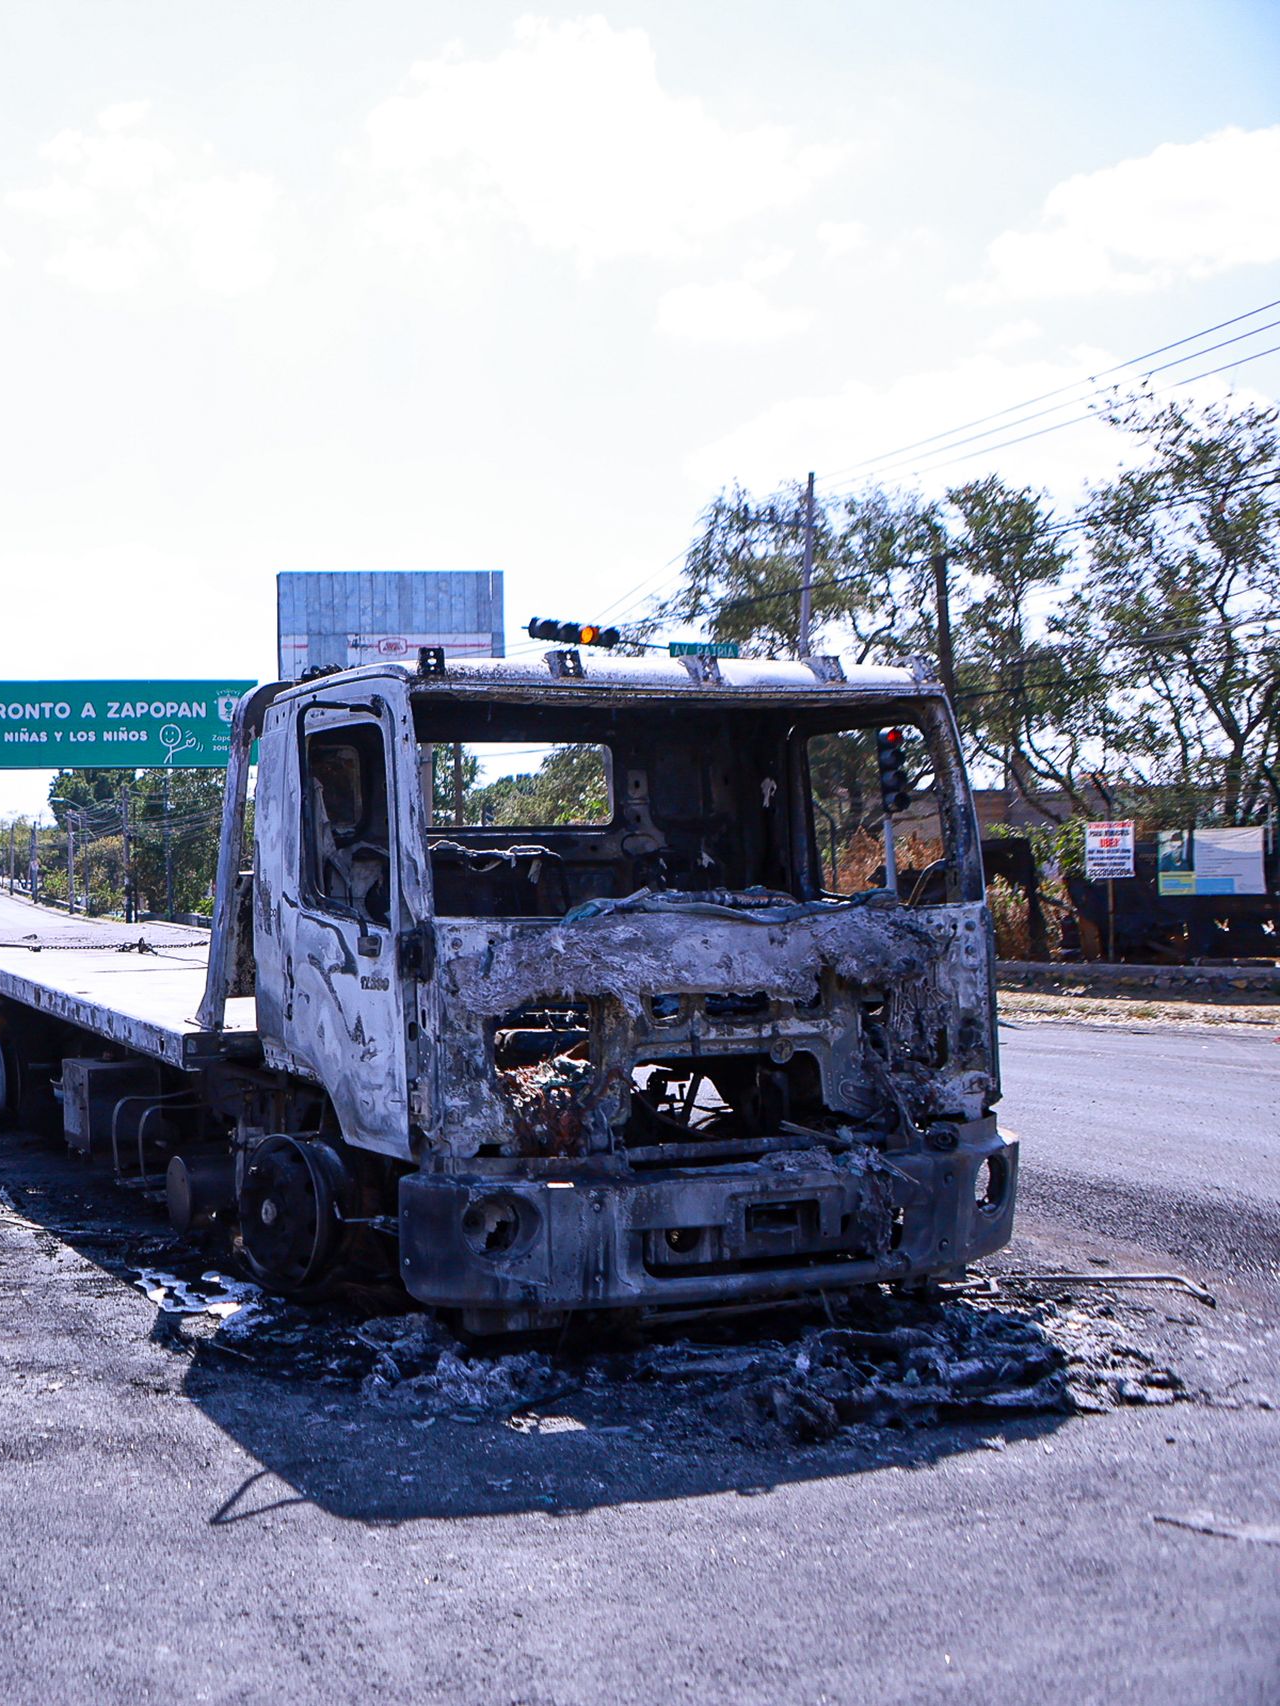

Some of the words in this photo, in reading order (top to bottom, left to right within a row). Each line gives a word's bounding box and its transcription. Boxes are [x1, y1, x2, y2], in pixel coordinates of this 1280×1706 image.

[674, 644, 688, 656] AV
[696, 645, 735, 658] PATRIA
[81, 702, 97, 718] A
[107, 701, 207, 718] ZAPOPAN
[4, 727, 48, 742] NIÑAS
[54, 731, 63, 742] Y
[70, 731, 96, 742] LOS
[103, 727, 148, 742] NIÑOS
[212, 734, 231, 742] Zapo
